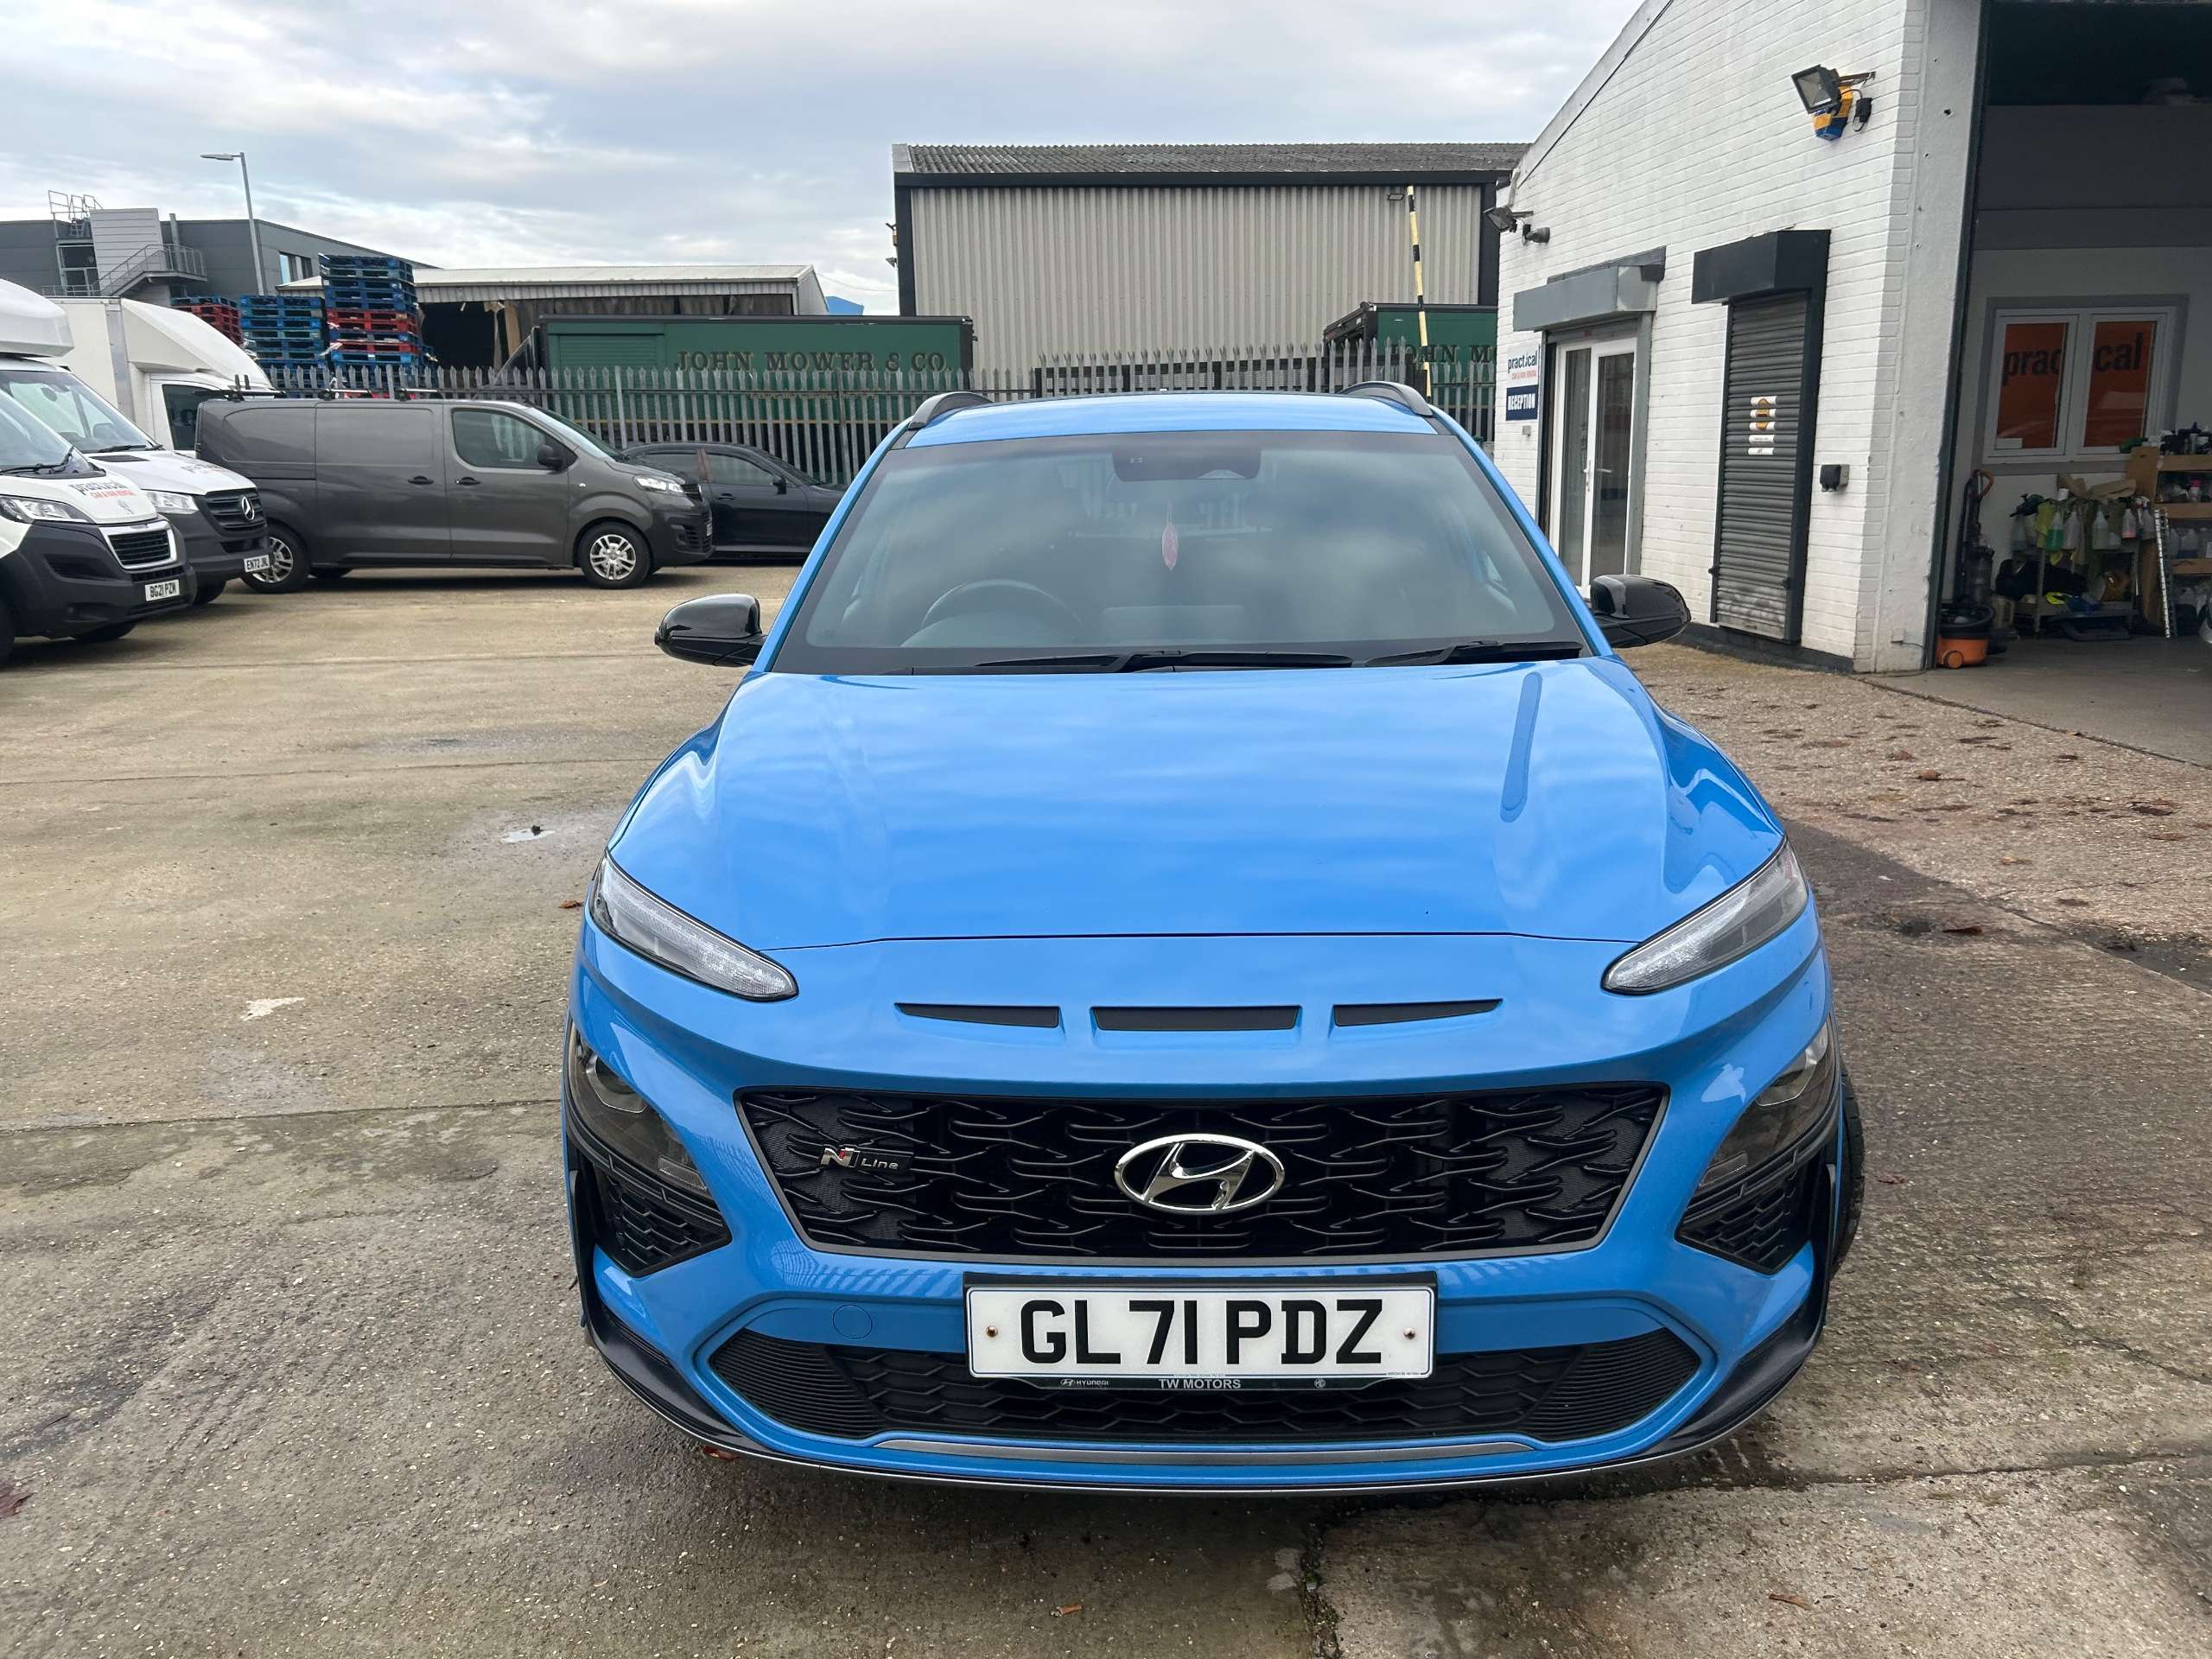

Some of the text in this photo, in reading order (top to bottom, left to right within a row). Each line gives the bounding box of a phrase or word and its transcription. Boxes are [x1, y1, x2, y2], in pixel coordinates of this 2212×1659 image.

[675, 351, 753, 372] JOHN
[764, 352, 874, 372] MOWER
[885, 353, 901, 372] &
[1508, 393, 1535, 410] RECEPTION
[861, 1158, 899, 1170] Line
[1225, 1299, 1382, 1365] PDZ
[1159, 1378, 1242, 1389] TW MOTORS
